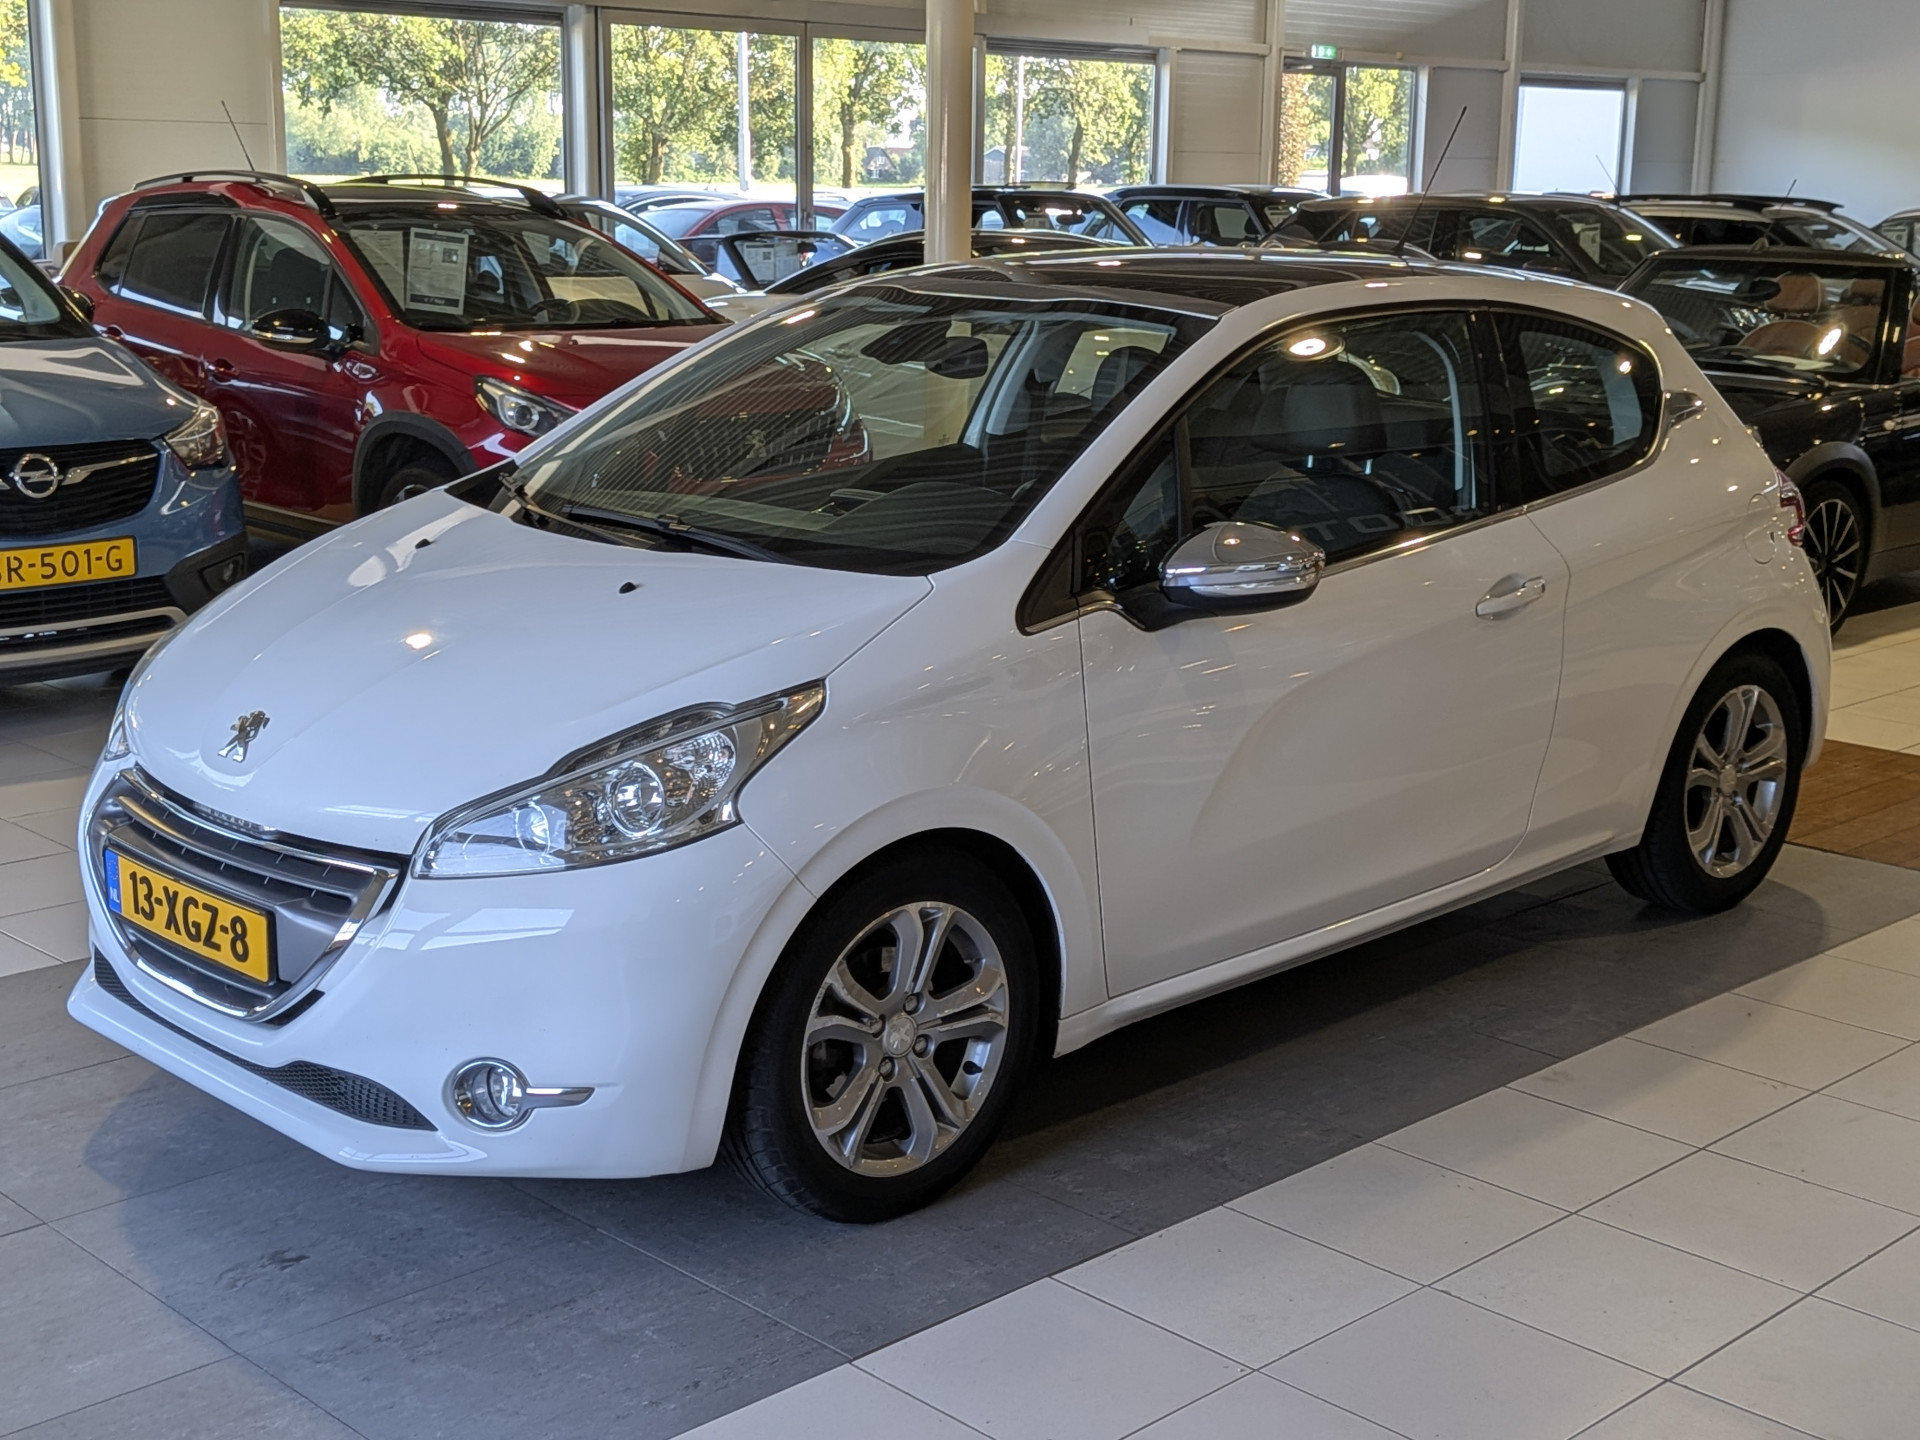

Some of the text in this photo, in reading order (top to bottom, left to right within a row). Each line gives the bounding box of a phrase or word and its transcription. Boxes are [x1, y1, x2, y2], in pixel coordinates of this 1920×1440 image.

[0, 545, 123, 583] R-501-G
[109, 886, 120, 904] NL
[129, 871, 250, 963] 13-XGZ-8
